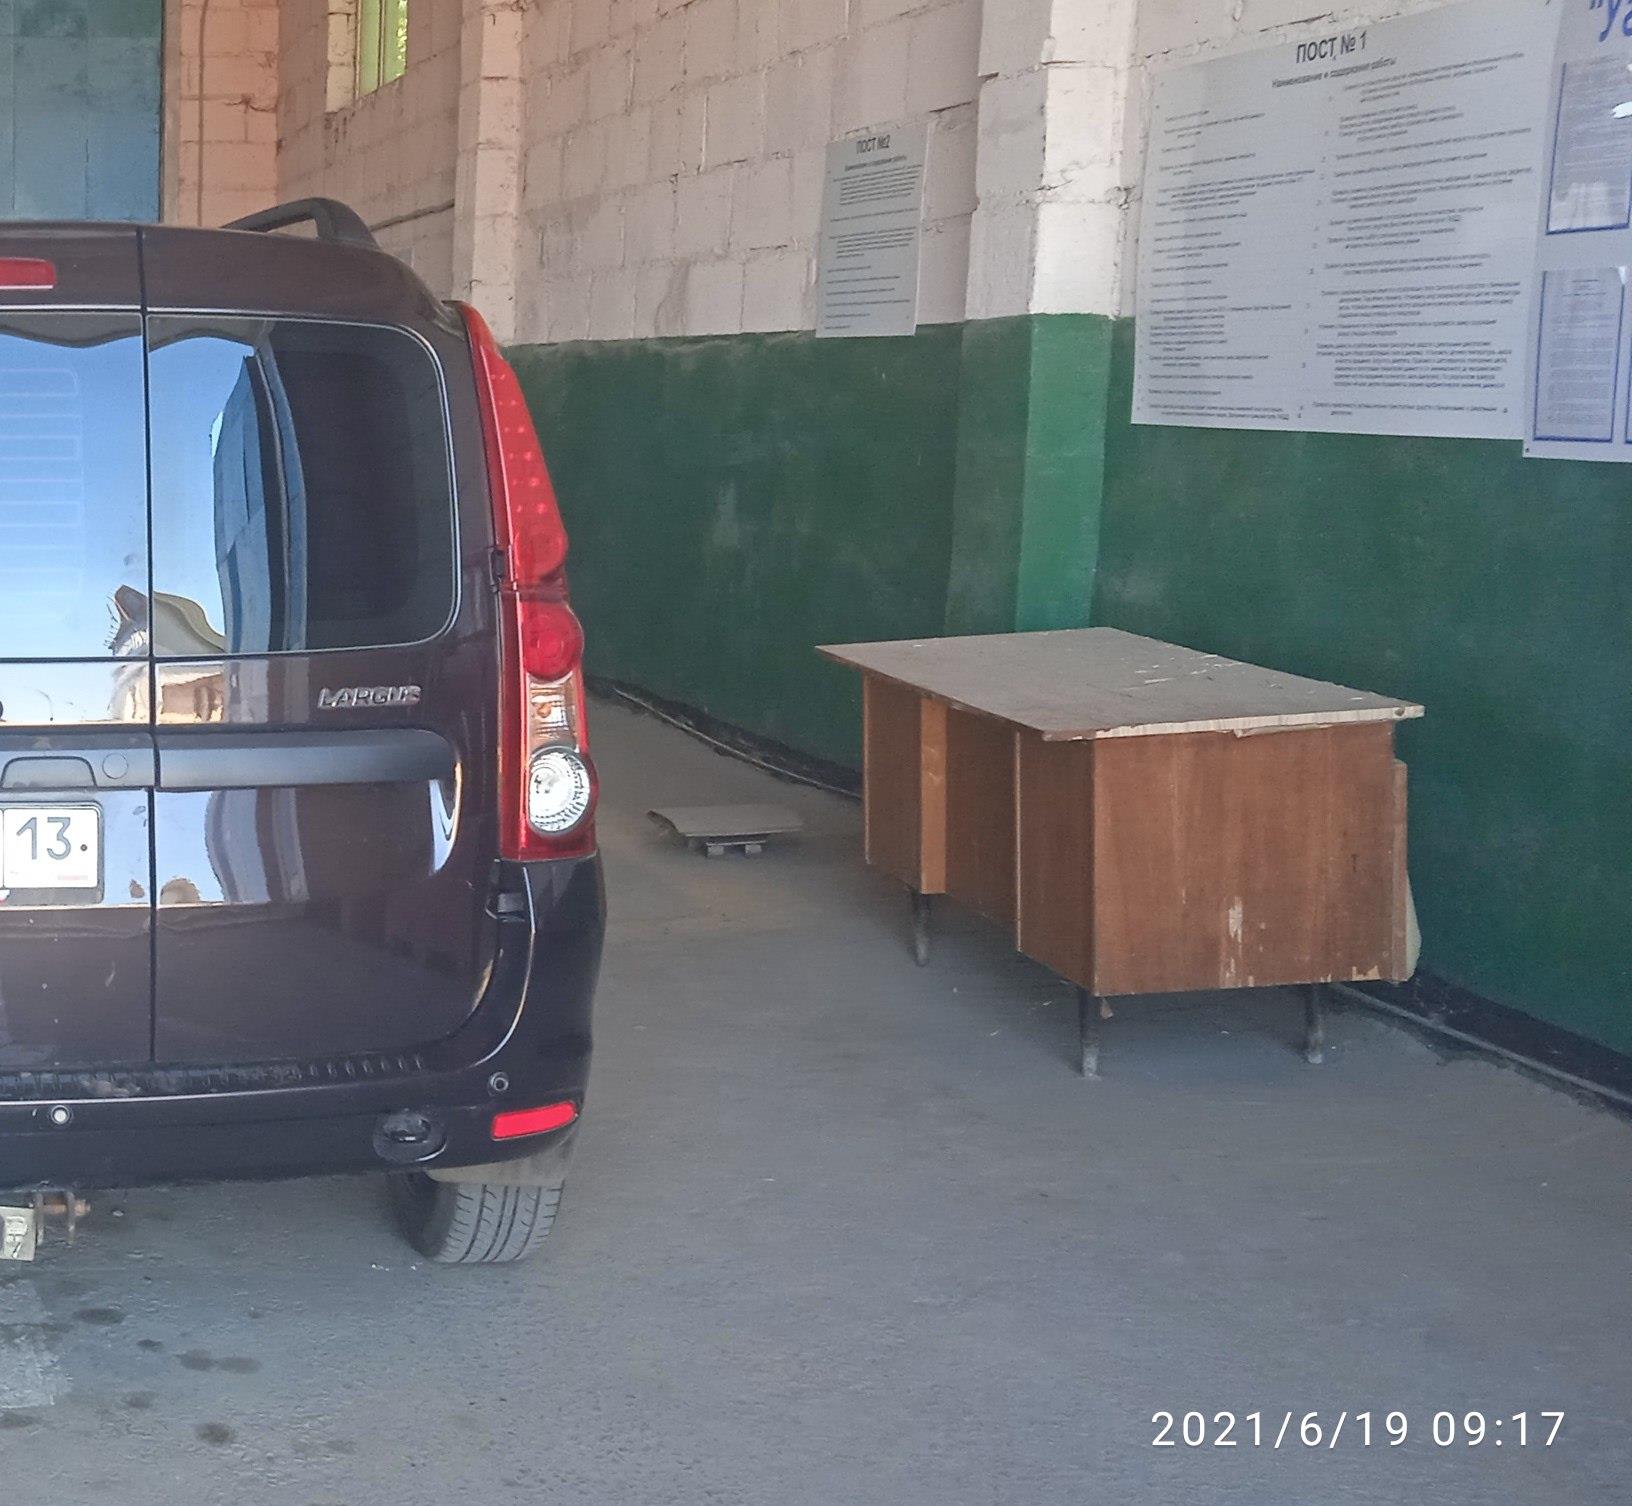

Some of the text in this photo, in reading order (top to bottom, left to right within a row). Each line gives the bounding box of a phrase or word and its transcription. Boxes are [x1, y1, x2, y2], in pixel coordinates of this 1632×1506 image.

[1296, 31, 1367, 63] ПОСТ № 1
[856, 137, 876, 154] ПОСТ
[318, 686, 421, 708] LARGUS
[17, 817, 71, 860] 13
